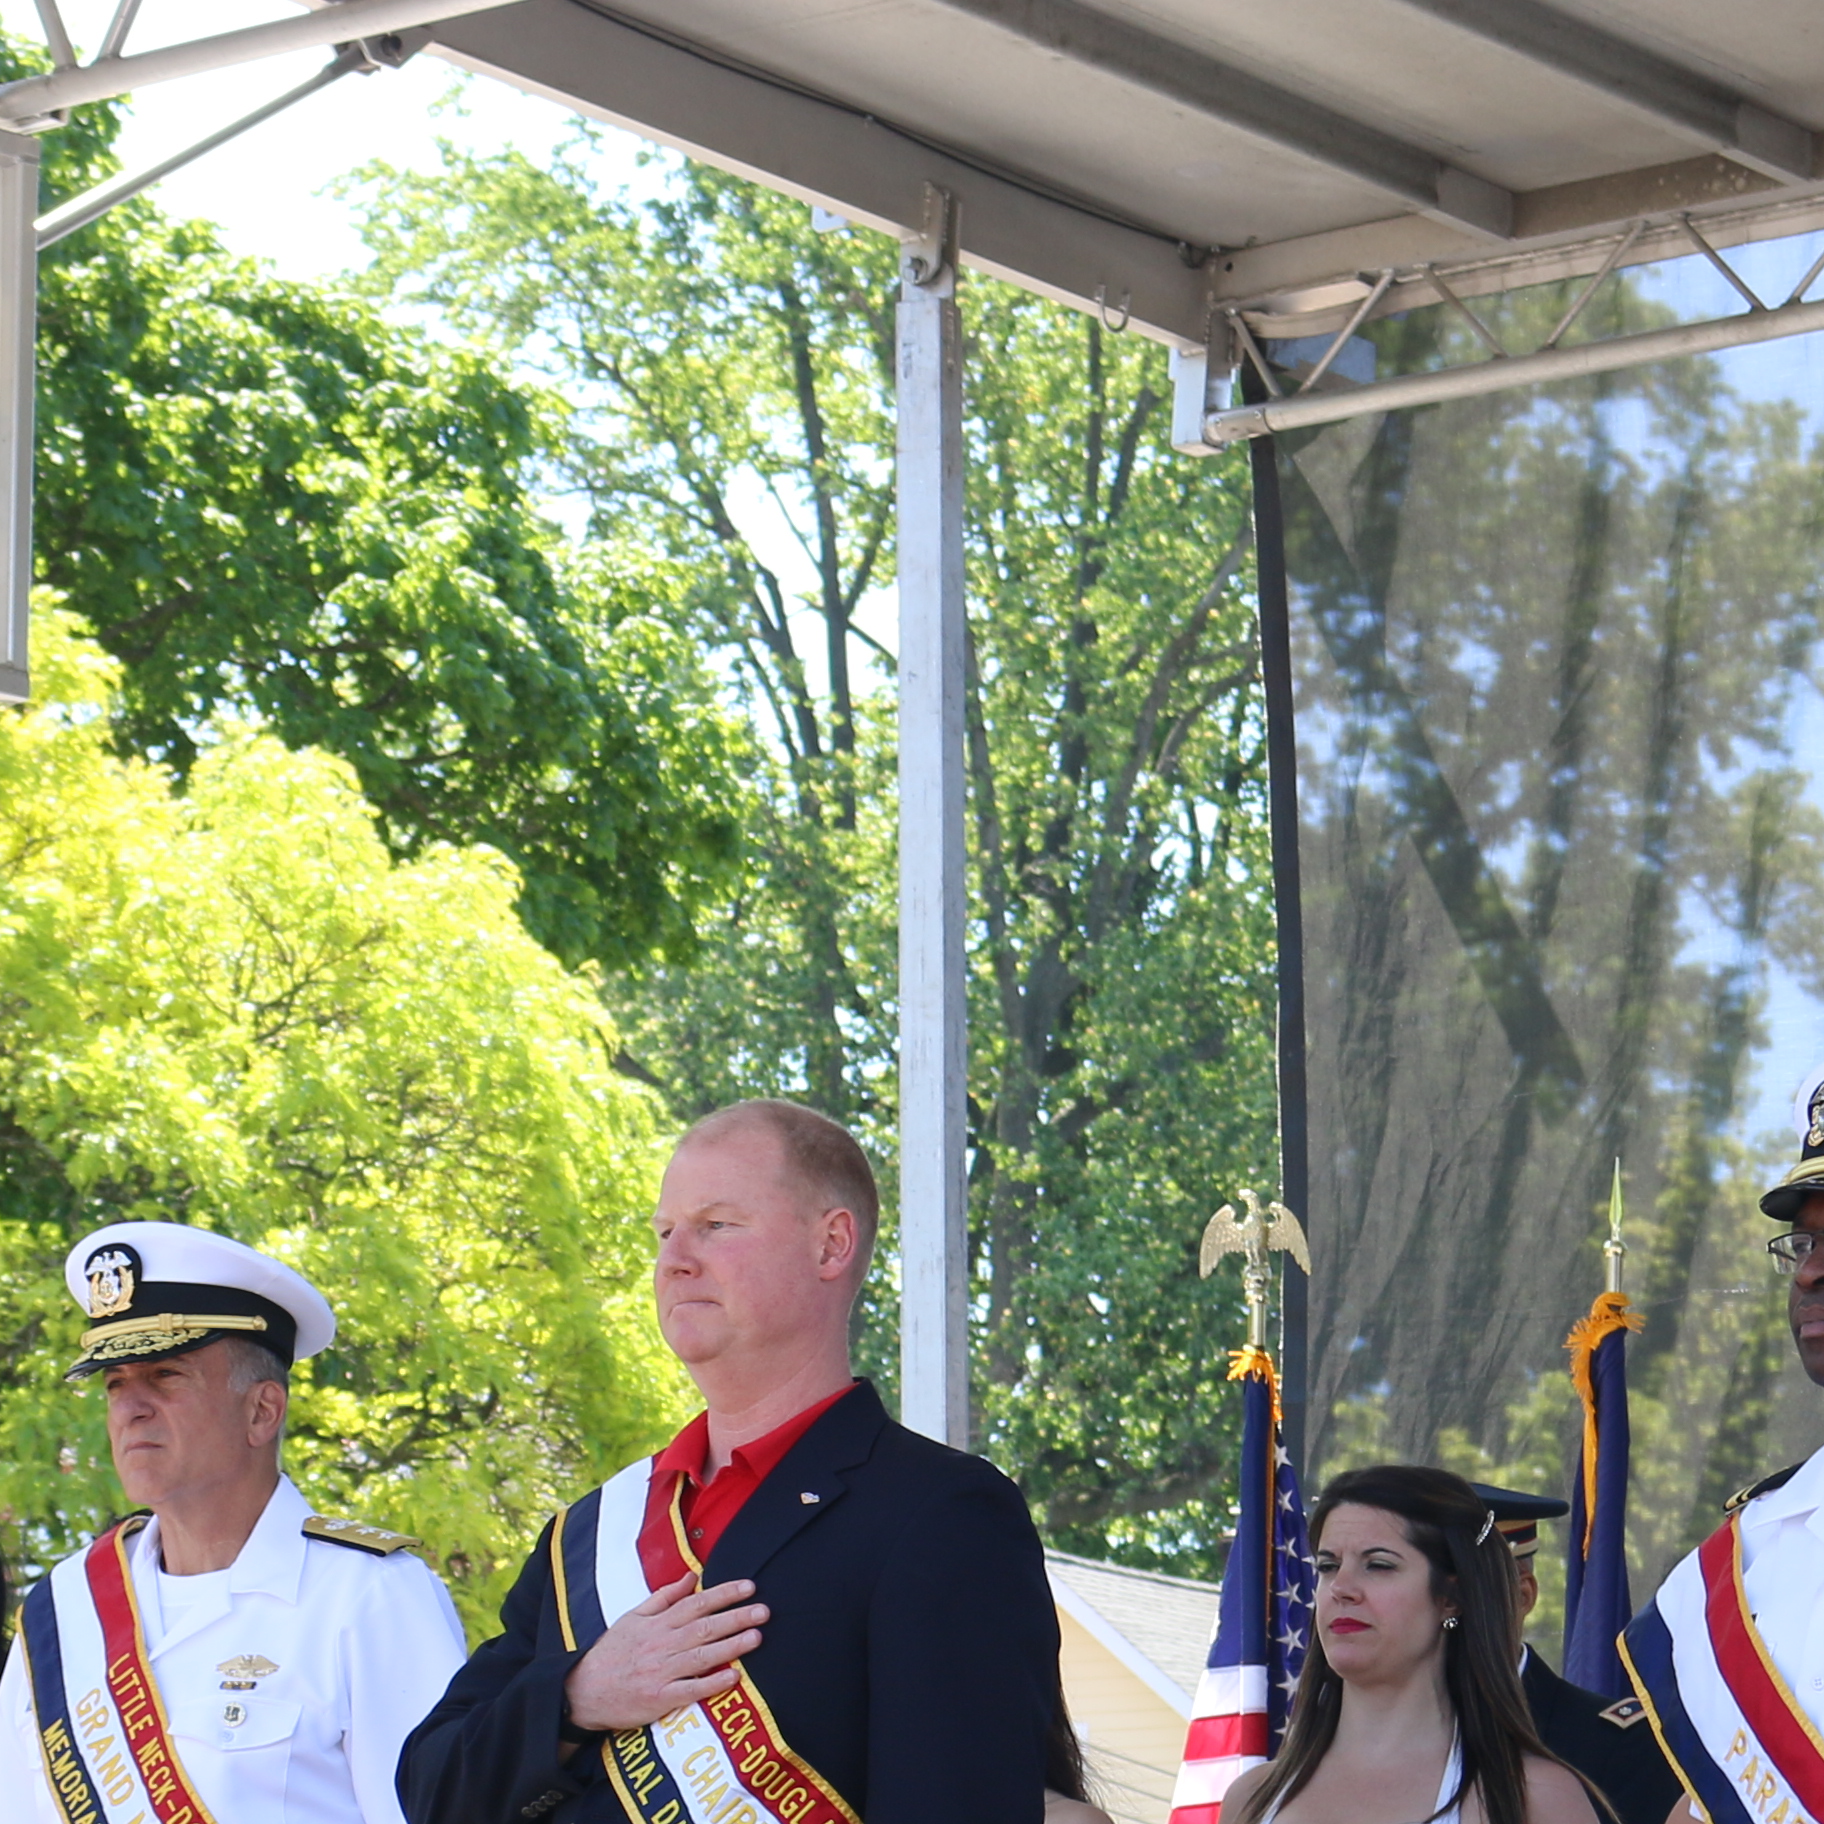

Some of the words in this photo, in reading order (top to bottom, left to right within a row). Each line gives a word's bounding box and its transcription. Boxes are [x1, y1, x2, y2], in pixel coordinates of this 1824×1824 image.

[108, 1652, 152, 1741] LITTLE
[75, 1688, 134, 1807] GRAND
[615, 1728, 666, 1806] ORIAL
